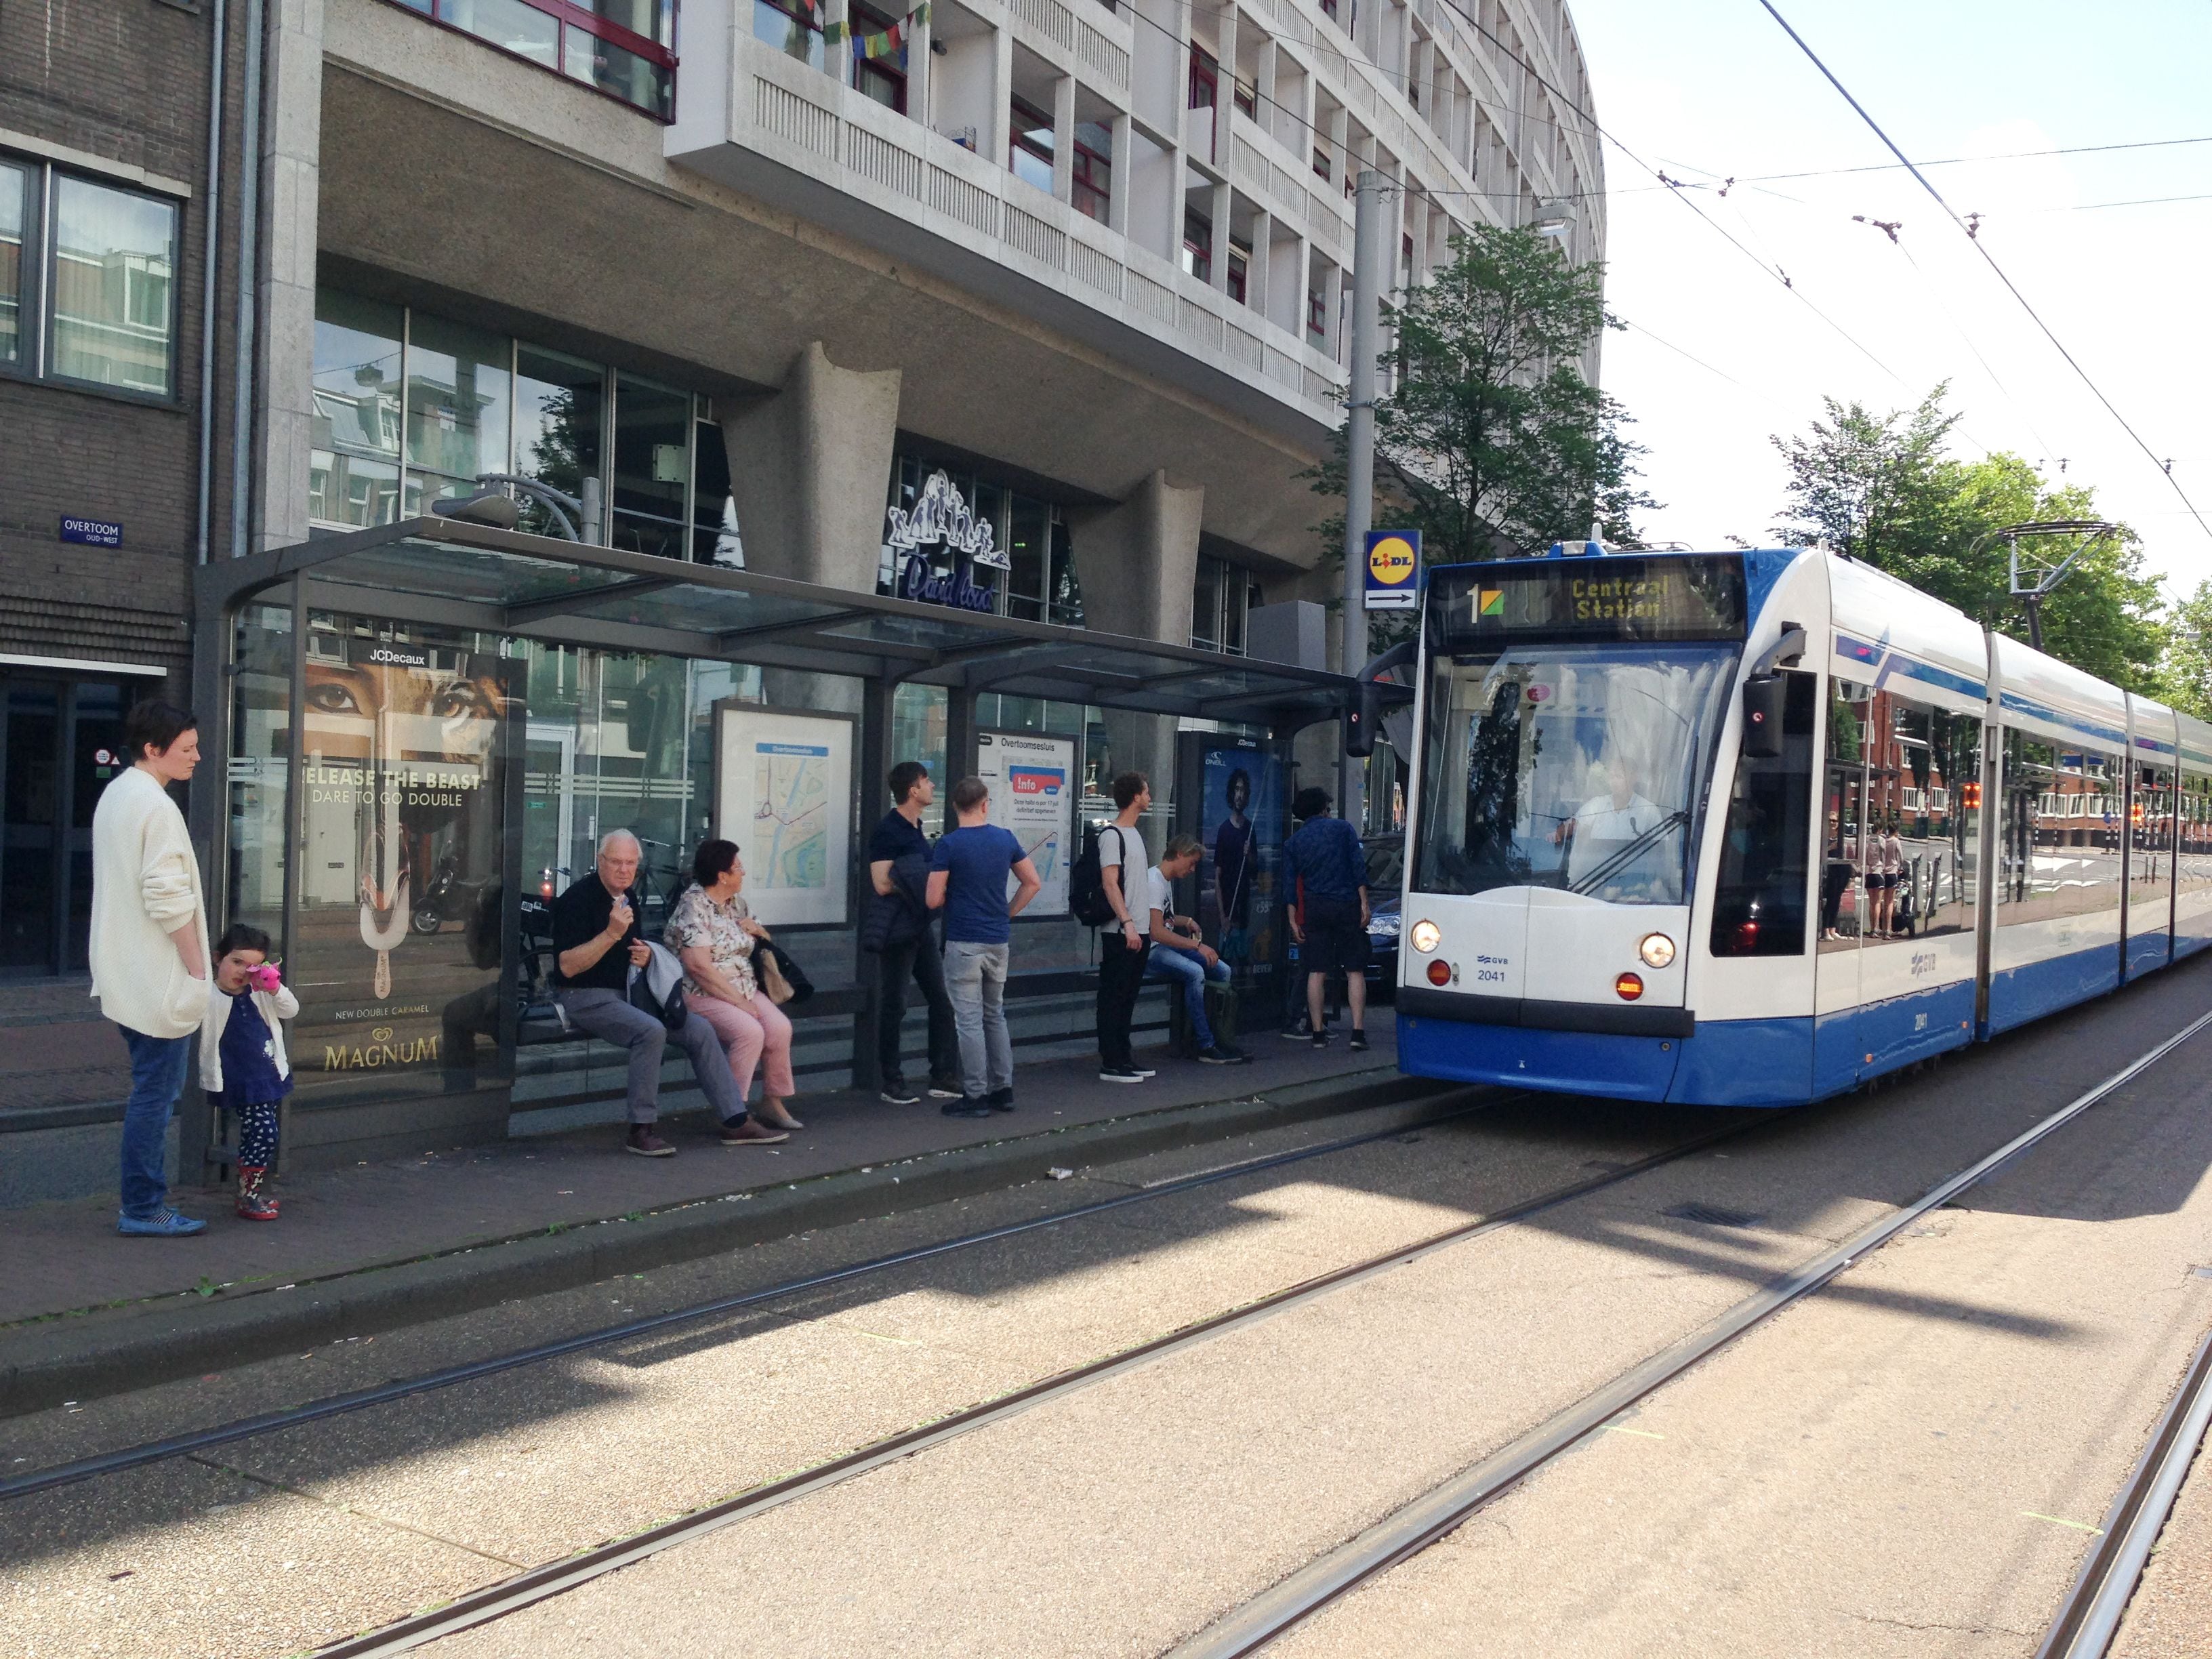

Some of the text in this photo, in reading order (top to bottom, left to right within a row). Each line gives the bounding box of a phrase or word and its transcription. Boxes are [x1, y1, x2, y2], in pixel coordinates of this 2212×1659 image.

[65, 520, 118, 535] OVERTOOM
[86, 535, 117, 544] OUD-WEST
[899, 551, 956, 602] David
[1572, 575, 1669, 599] Centraal
[1467, 583, 1479, 623] 1
[1576, 596, 1660, 620] Station
[370, 649, 425, 665] JCDecaux
[1001, 737, 1054, 751] Overtoomsesluis
[383, 771, 418, 788] THE
[426, 773, 480, 790] BEAST
[312, 790, 462, 806] DARE TO GO DOUBLE
[1477, 970, 1505, 982] 2041
[335, 1004, 430, 1020] NEW DOUBLE CARAMEL
[325, 1035, 438, 1071] MAGNUM
